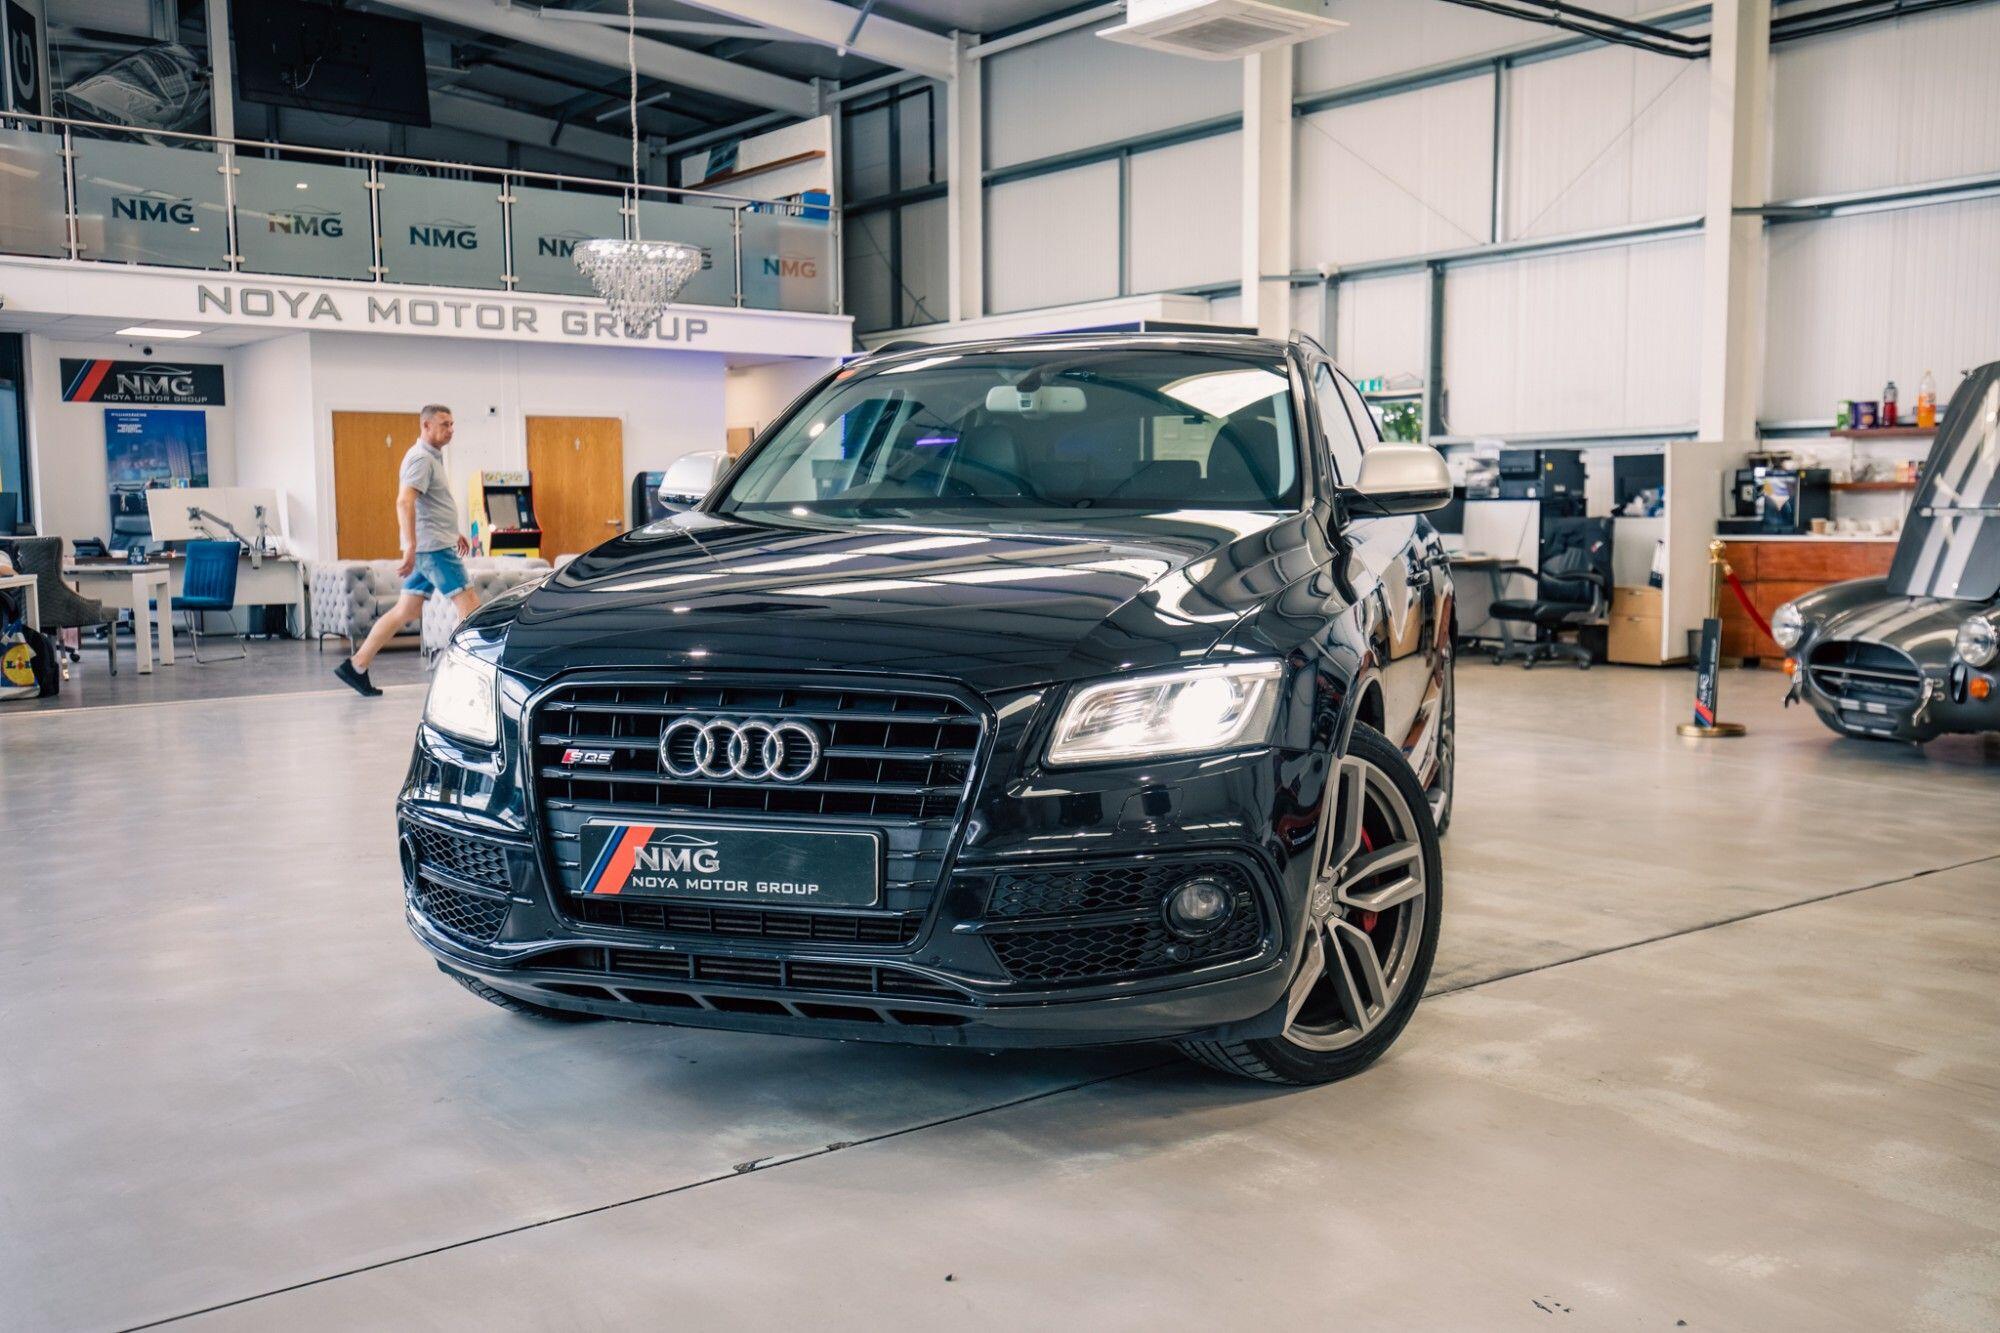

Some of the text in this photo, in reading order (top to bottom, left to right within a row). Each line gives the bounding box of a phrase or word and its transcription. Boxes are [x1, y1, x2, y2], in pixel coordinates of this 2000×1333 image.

[111, 196, 194, 225] NMG
[268, 211, 344, 238] NMG
[409, 225, 478, 250] NMG
[538, 237, 578, 258] NM
[763, 257, 817, 278] NMG
[197, 284, 343, 322] NOYA
[367, 296, 539, 334] MOTOR
[116, 373, 195, 396] NMG
[103, 393, 208, 404] NOYA MOTOR GROUP
[567, 750, 612, 764] SQ5
[633, 846, 720, 874] NMG
[631, 875, 819, 896] NOYA MOTOR GROUP
